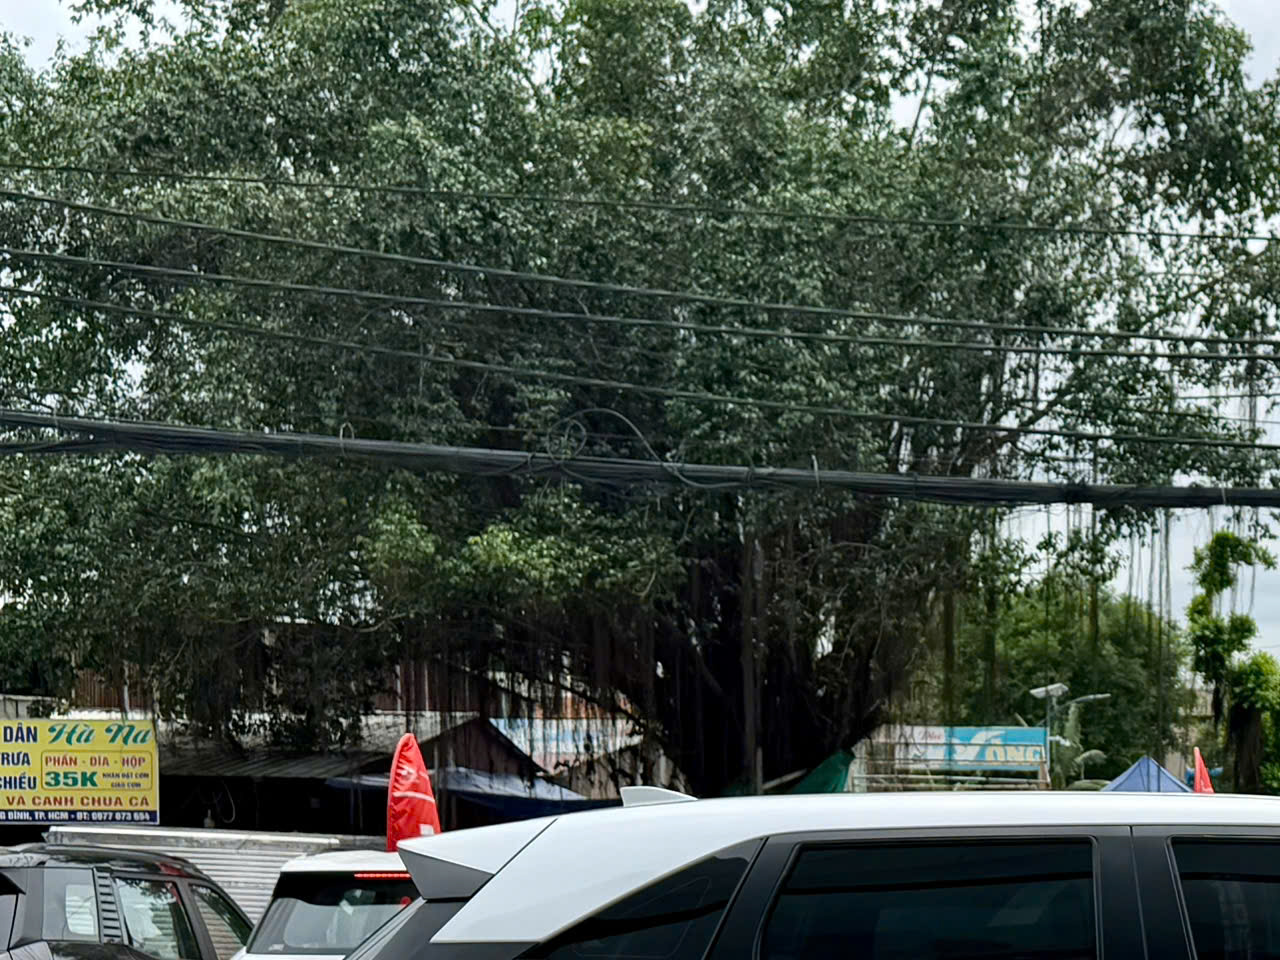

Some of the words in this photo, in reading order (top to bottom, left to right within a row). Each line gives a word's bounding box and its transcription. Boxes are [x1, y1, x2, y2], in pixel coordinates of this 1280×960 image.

[3, 722, 38, 743] DÂN
[45, 771, 98, 788] 35K
[31, 796, 74, 807] CANH
[80, 796, 123, 807] CHUA
[48, 811, 69, 820] HCM
